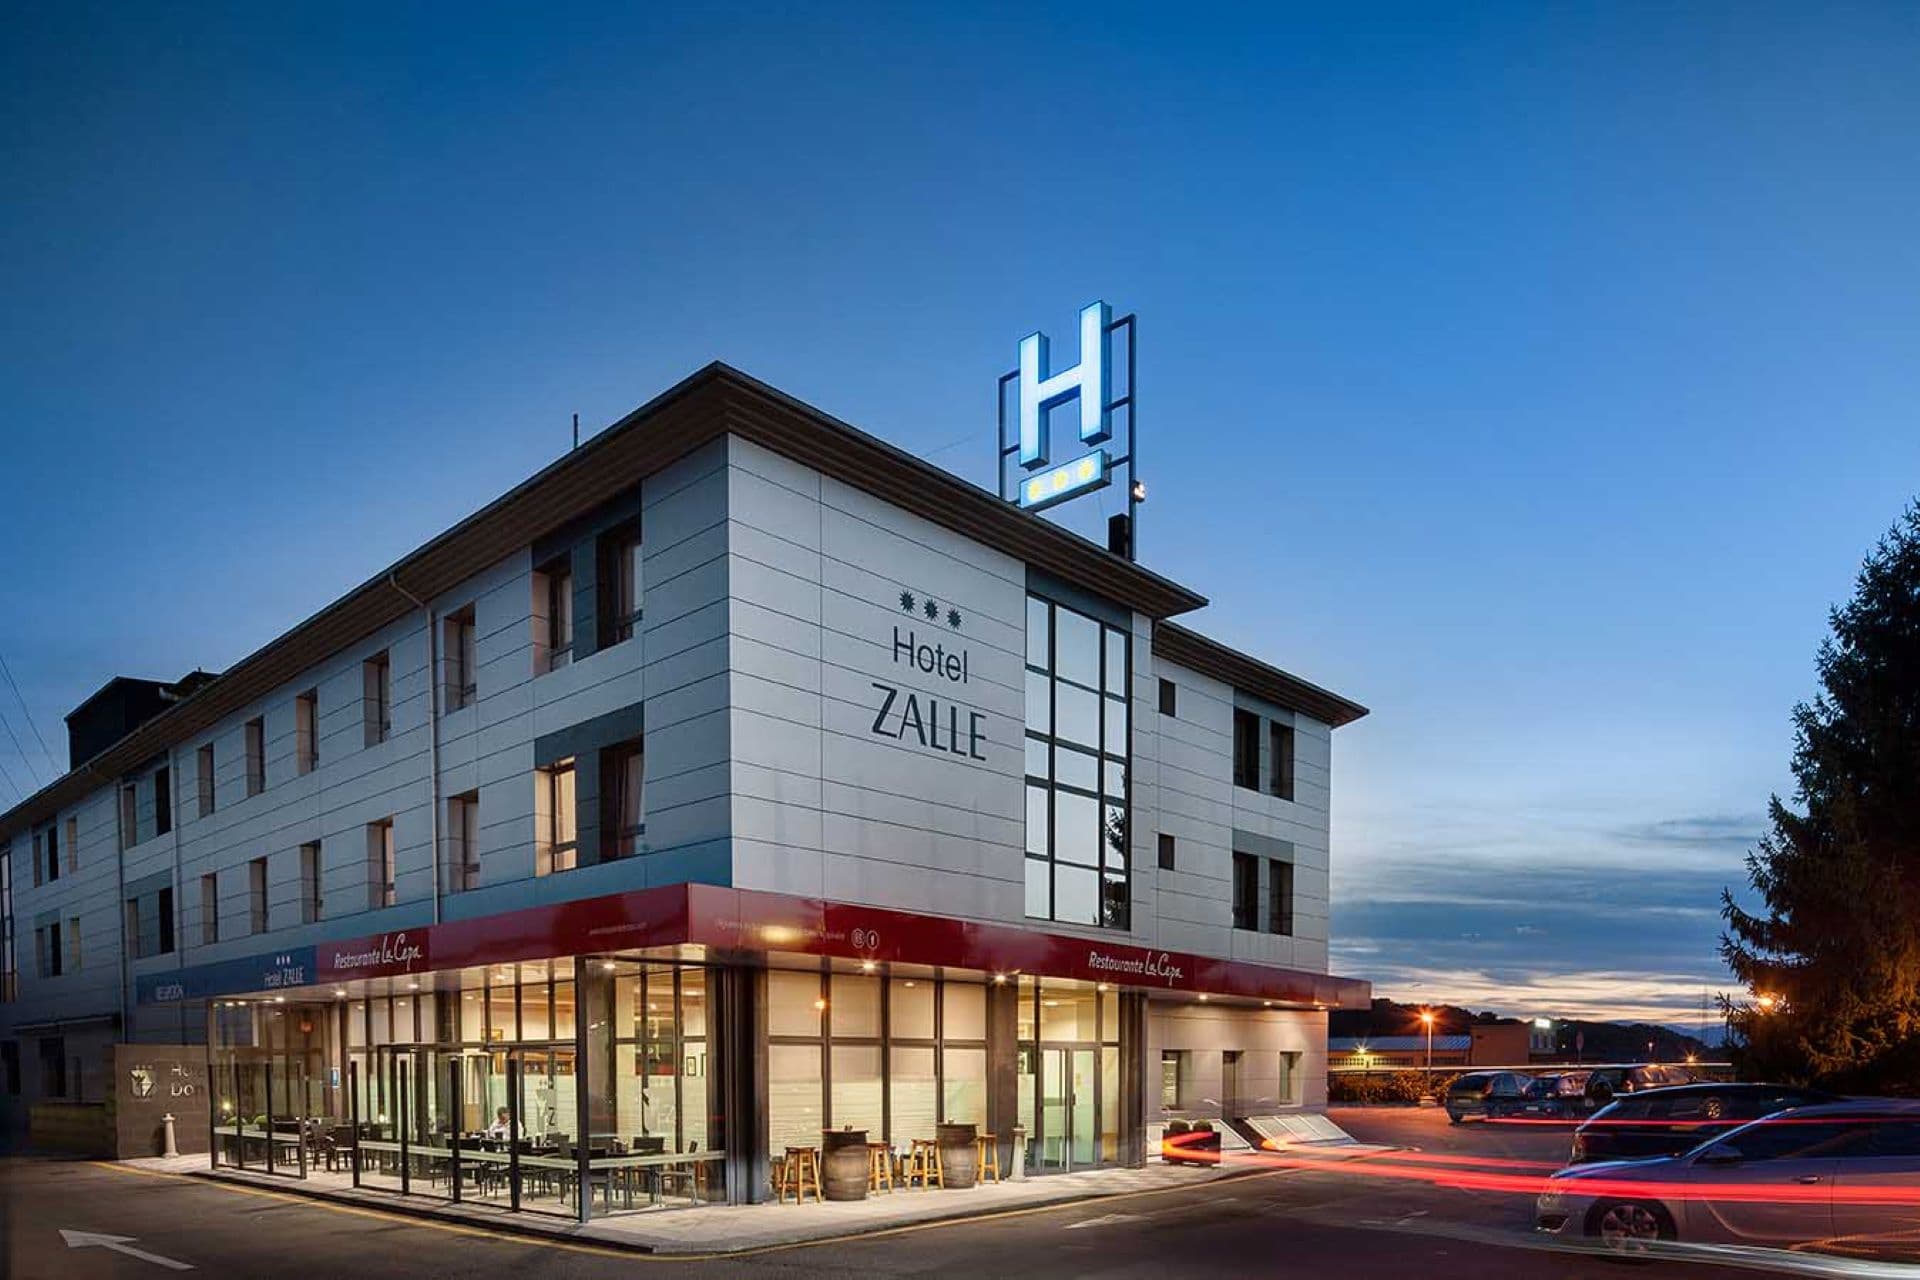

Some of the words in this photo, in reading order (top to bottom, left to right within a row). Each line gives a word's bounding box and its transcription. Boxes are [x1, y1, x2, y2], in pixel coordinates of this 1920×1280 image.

[1018, 300, 1110, 469] H
[893, 625, 968, 684] Hotel
[871, 682, 987, 761] ZALLE
[282, 966, 304, 985] ZALLE
[334, 949, 380, 969] Restaurante
[381, 935, 394, 964] La
[394, 933, 423, 971] Cepa
[1088, 950, 1144, 974] Restaurante
[1145, 951, 1157, 976] La
[1157, 952, 1184, 986] Cepa
